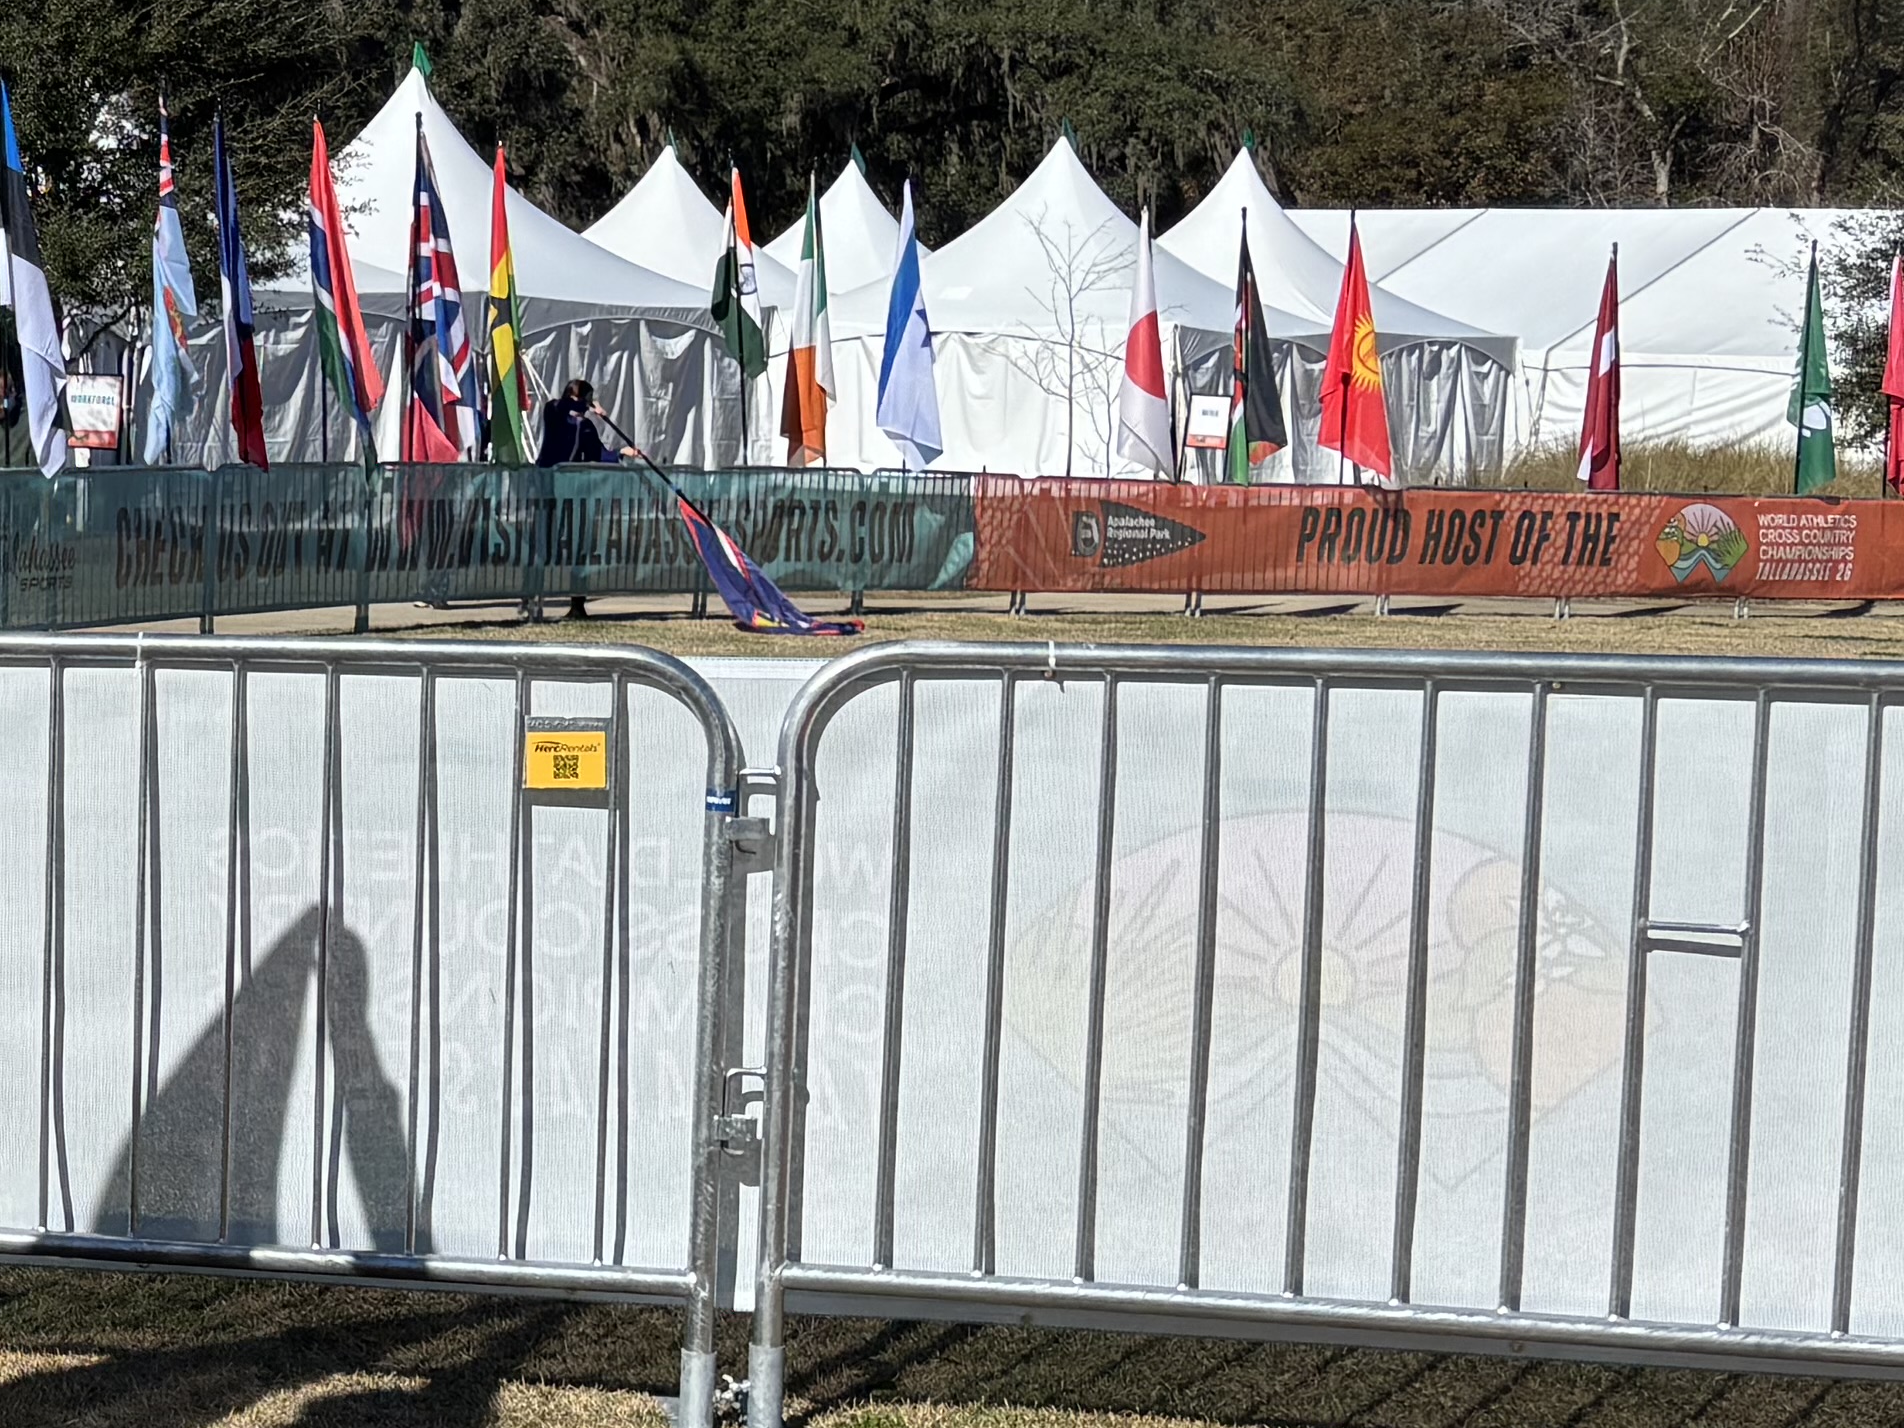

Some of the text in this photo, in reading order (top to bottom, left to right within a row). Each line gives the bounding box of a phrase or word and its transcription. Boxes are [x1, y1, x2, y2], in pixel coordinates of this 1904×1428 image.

[1107, 515, 1156, 528] Apalachee
[1757, 514, 1858, 528] WORLD ATHLETICS
[1107, 527, 1171, 541] Regional Park
[1296, 506, 1621, 568] PROUD HOST OF THE
[1759, 529, 1857, 544] CROSS COUNTRY
[116, 504, 207, 590] CHECK
[216, 502, 252, 584] US
[256, 500, 307, 578] OUT
[316, 498, 354, 574] AT
[1759, 545, 1855, 561] CHAMPIONSHIPS
[1755, 561, 1853, 581] TALLAHASSEE 26
[20, 574, 74, 592] SPORTS
